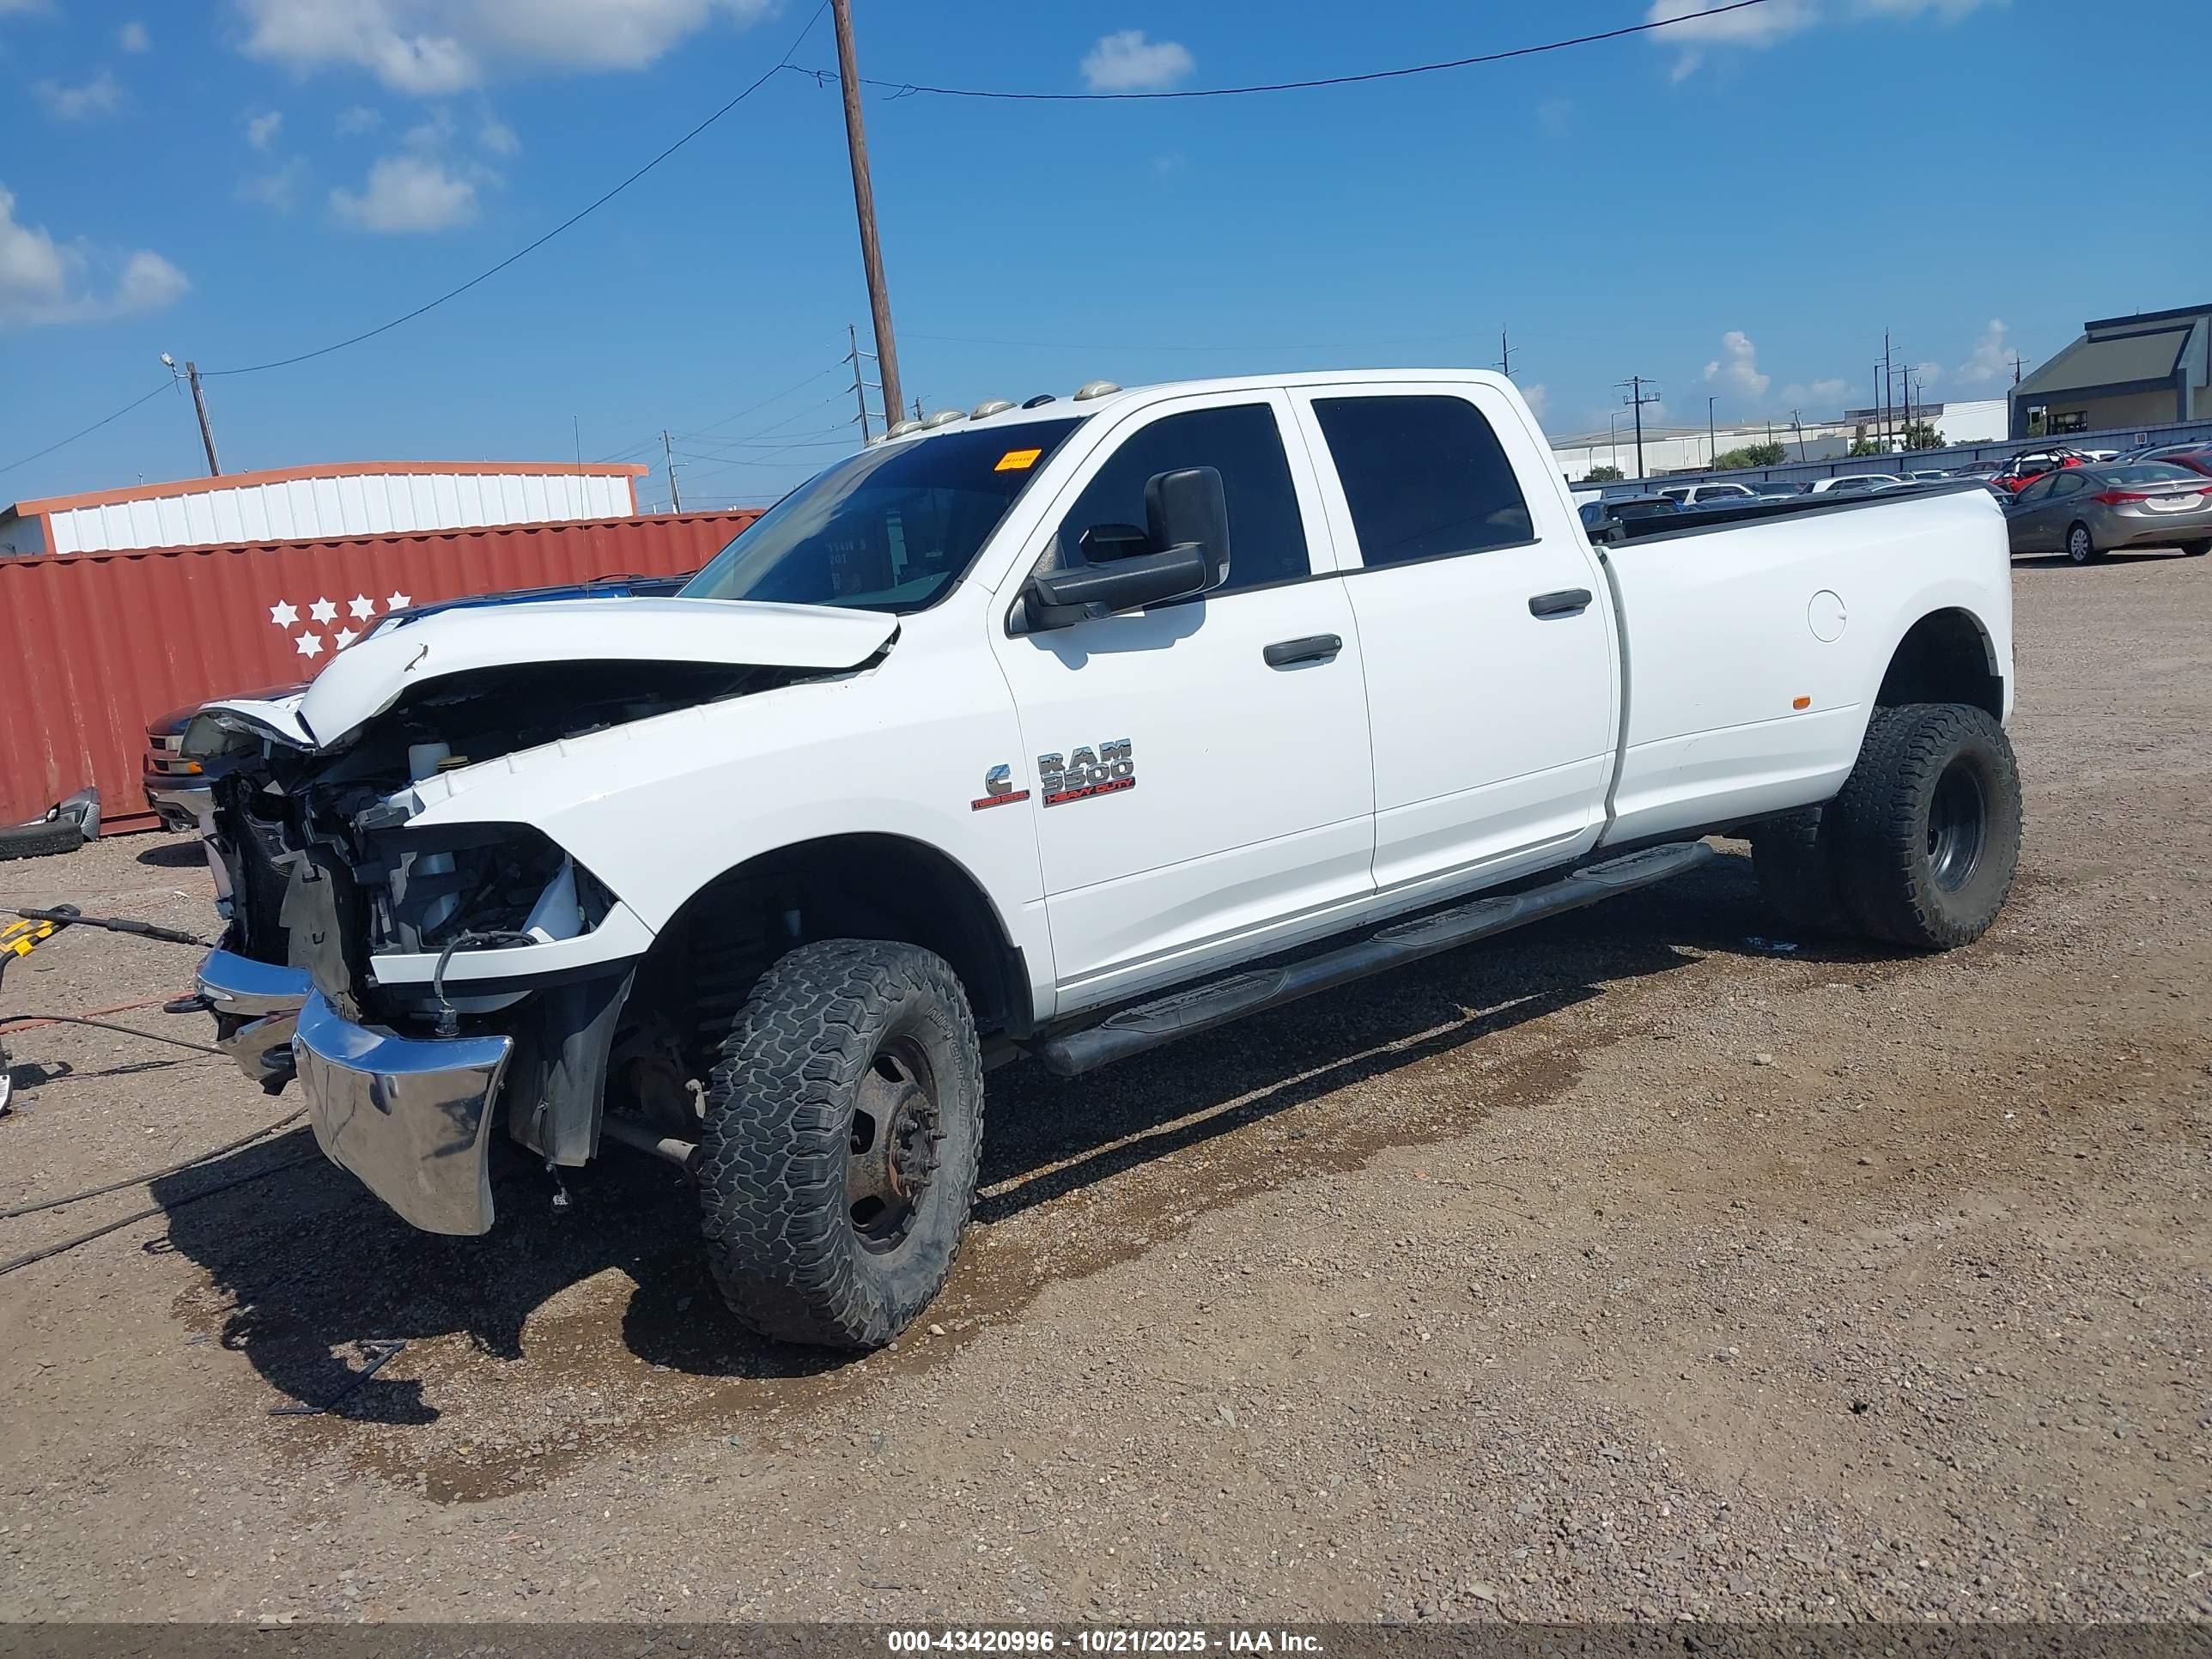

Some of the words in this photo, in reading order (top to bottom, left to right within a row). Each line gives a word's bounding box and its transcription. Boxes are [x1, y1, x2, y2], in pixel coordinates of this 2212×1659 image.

[2136, 434, 2146, 443] 10
[1037, 738, 1132, 775] RAM
[1041, 758, 1133, 794] 3500
[1047, 787, 1094, 805] HEAVY
[1095, 777, 1133, 793] DUTY
